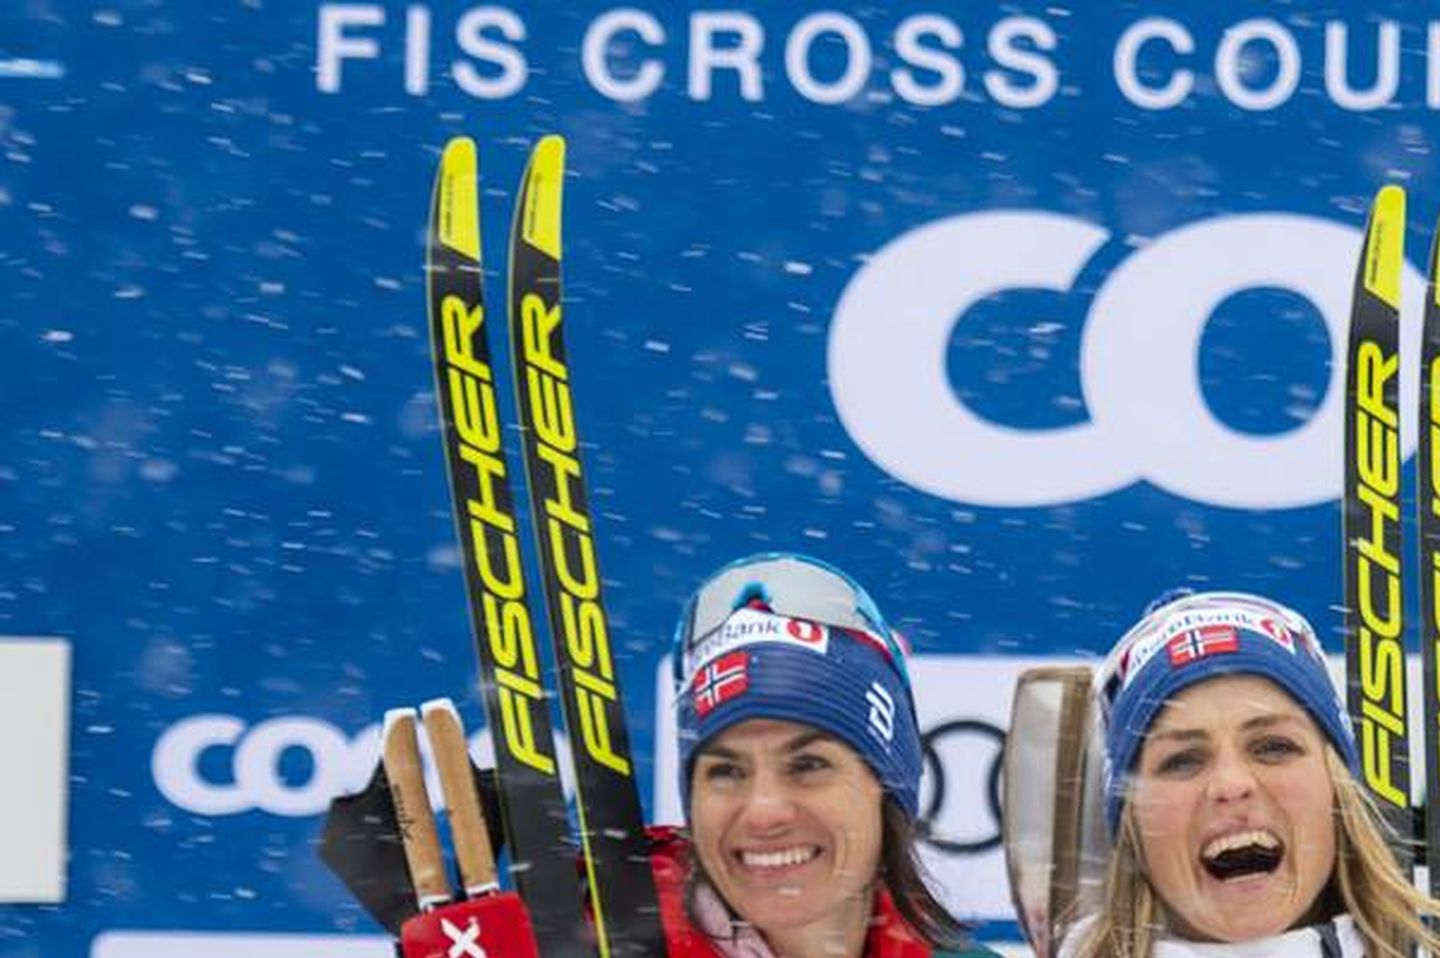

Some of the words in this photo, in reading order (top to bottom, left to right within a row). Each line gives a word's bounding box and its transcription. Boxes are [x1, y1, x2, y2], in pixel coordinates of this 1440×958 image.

[316, 6, 527, 102] FIS
[582, 12, 1059, 107] CROSS
[441, 293, 556, 774] FISCHER
[520, 293, 630, 775] FISCHER
[1356, 341, 1408, 807] FISCHER
